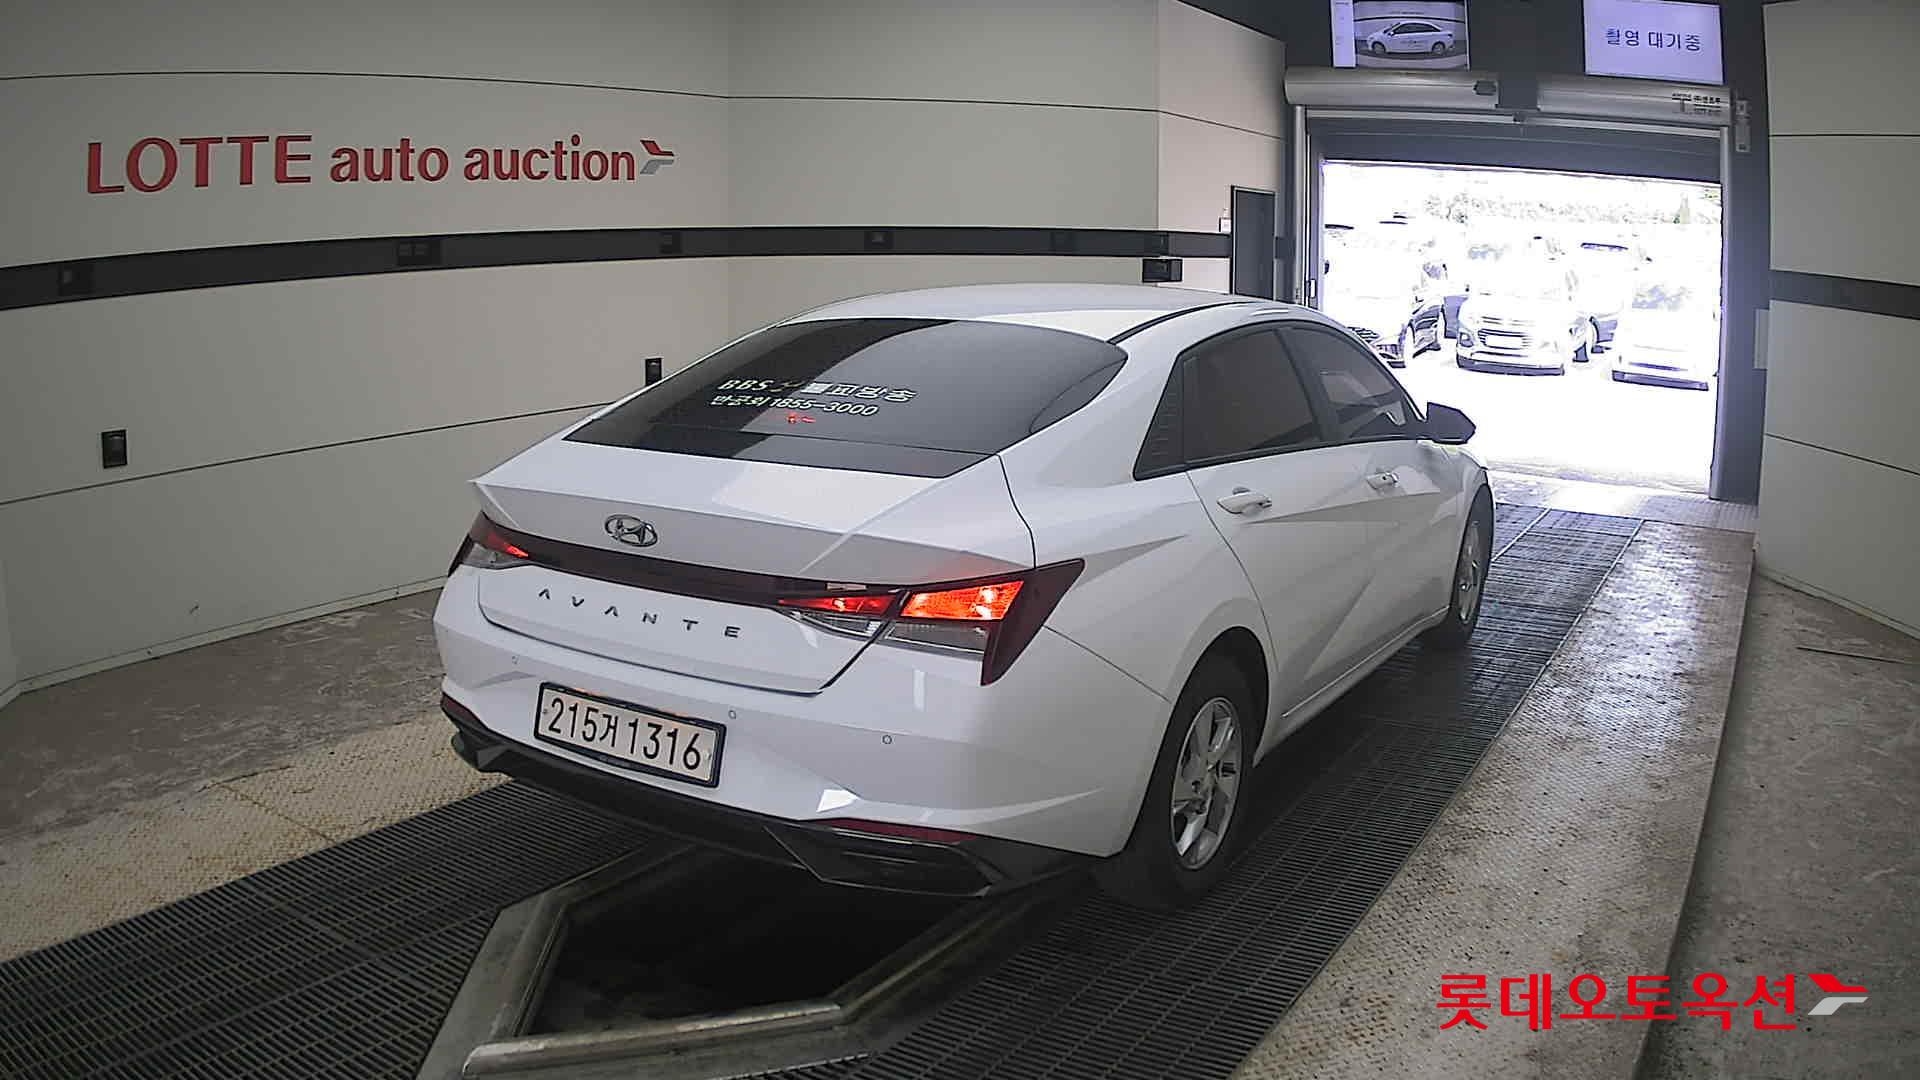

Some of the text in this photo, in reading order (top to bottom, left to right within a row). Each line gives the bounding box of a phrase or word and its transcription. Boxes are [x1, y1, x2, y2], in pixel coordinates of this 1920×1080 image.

[87, 135, 636, 194] LOTTE auto auction
[718, 379, 774, 391] BBS
[768, 397, 879, 417] 1855-3000
[538, 587, 741, 639] AVANTE
